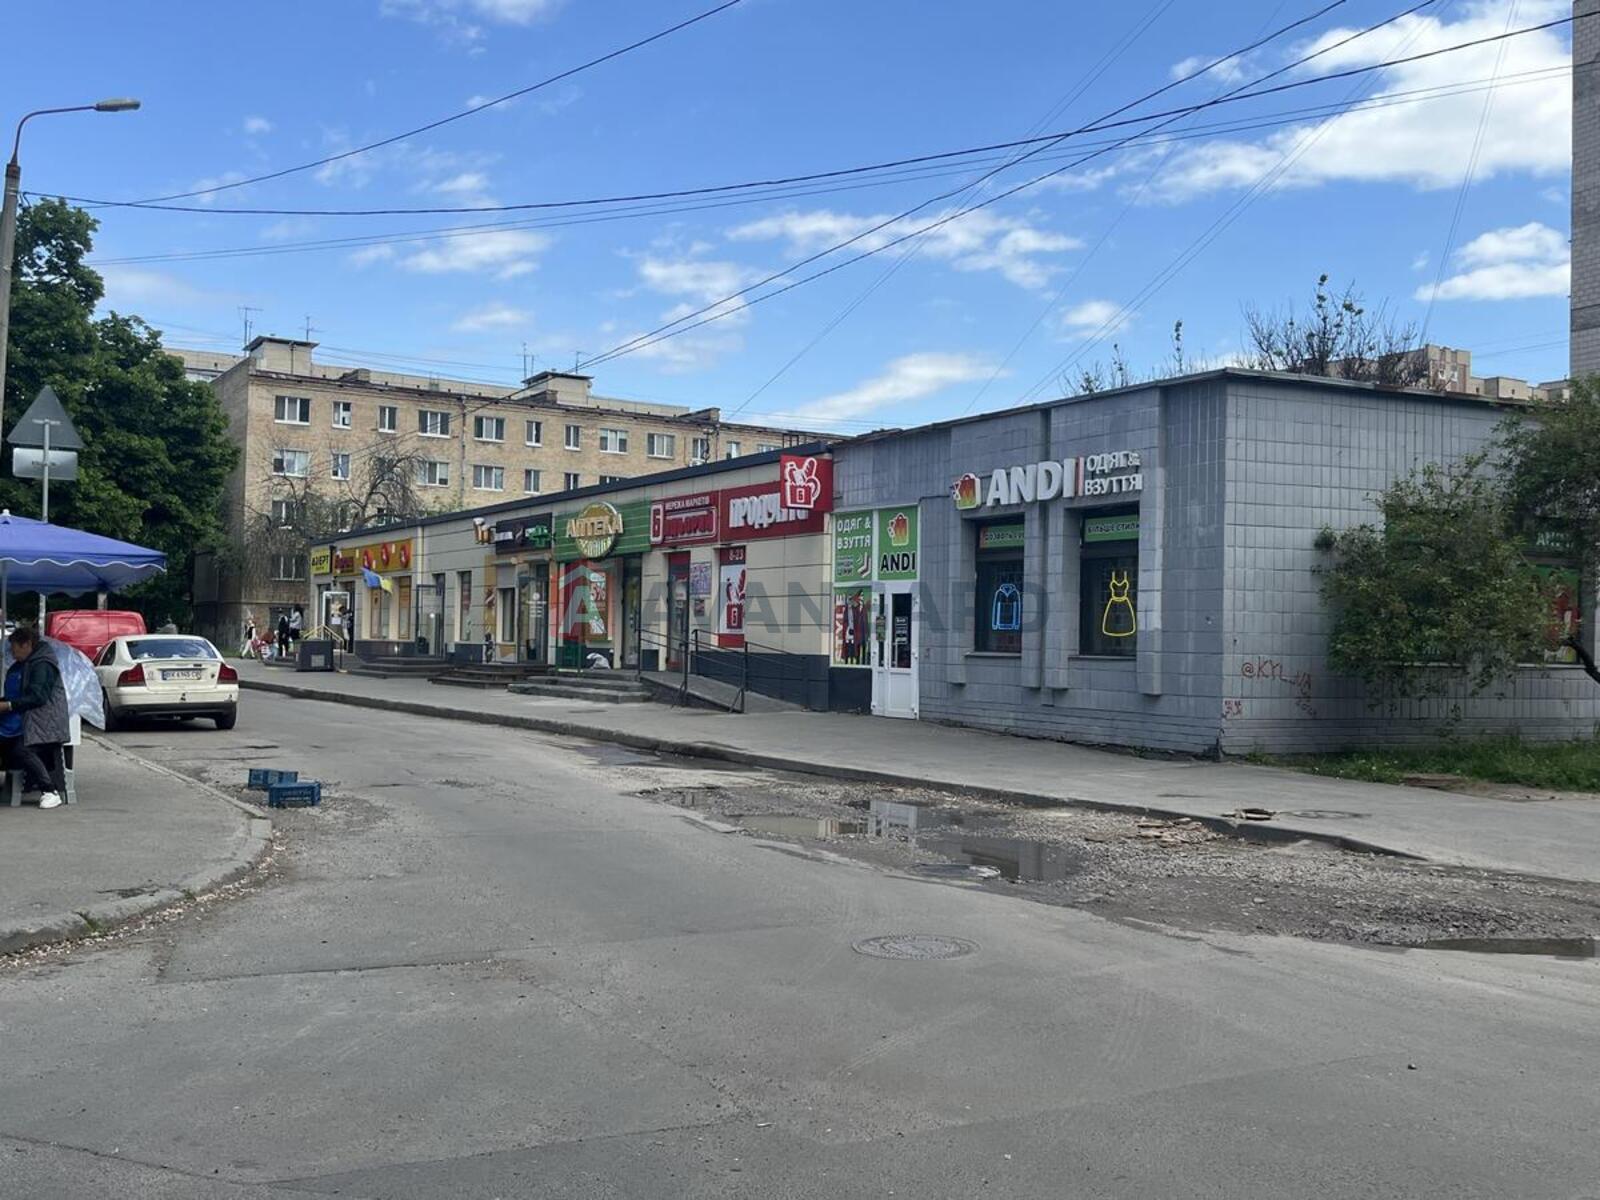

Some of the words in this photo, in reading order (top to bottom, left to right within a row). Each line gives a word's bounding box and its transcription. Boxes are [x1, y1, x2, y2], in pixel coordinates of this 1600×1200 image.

[1086, 450, 1129, 474] ОДЯГ
[986, 458, 1077, 507] ANDI
[1084, 473, 1143, 496] ВЗУТТЯ
[565, 512, 624, 539] АПТЕКА
[837, 517, 862, 534] ОДЯГ
[837, 534, 872, 550] ВЗУТТЯ
[880, 551, 917, 573] ANDI
